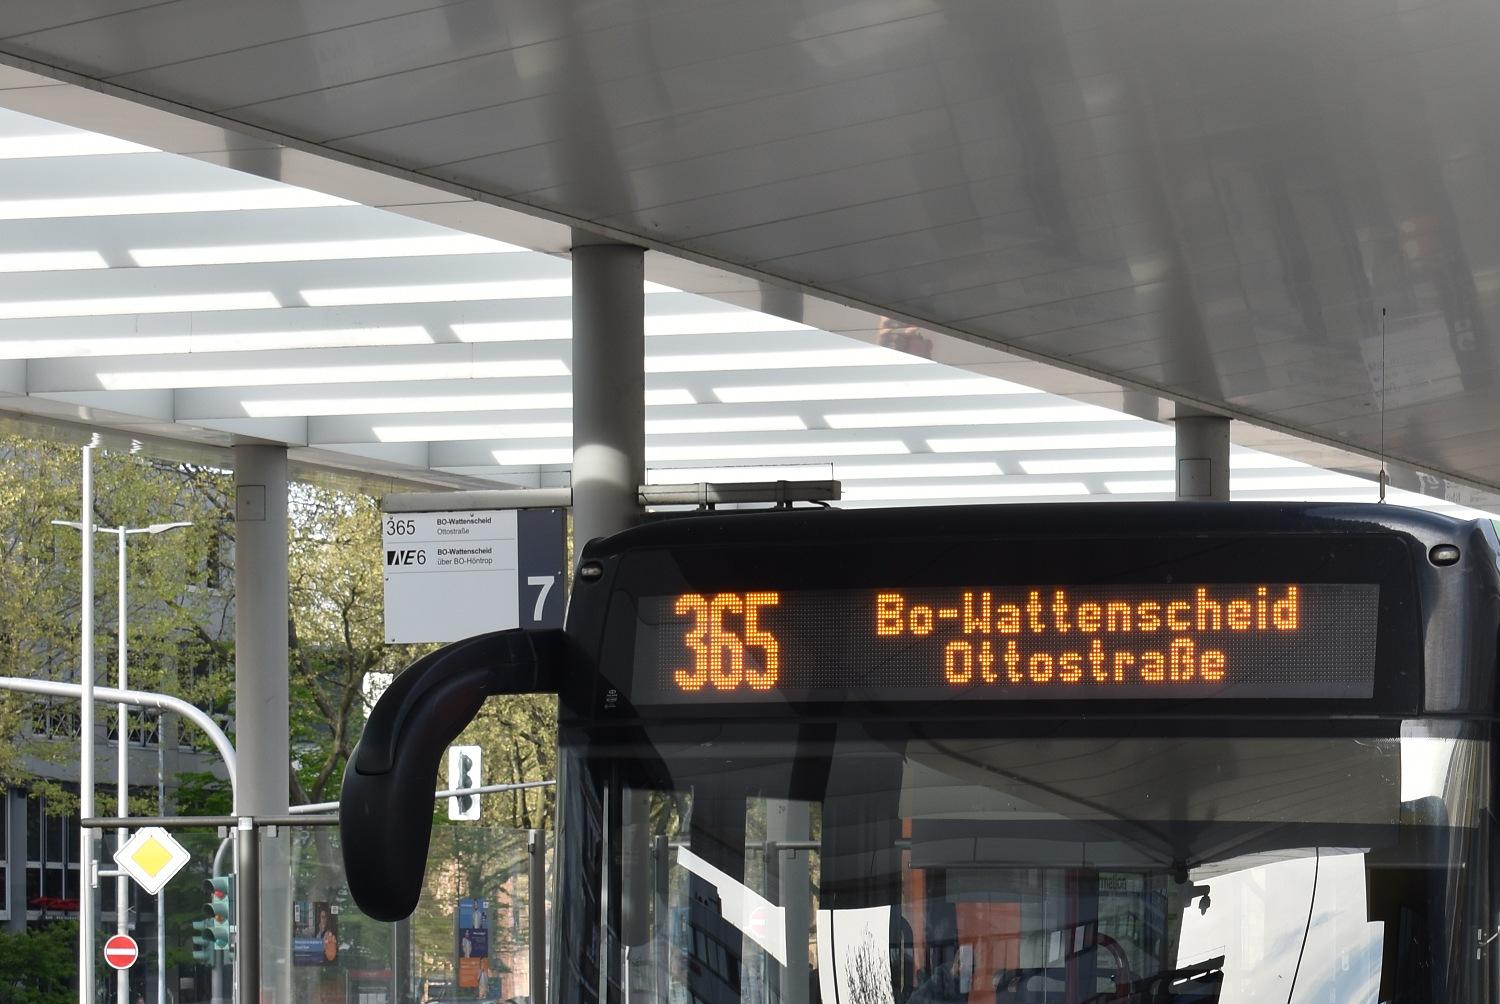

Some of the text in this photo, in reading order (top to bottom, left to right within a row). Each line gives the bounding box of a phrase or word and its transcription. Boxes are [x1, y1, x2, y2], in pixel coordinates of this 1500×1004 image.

[386, 519, 416, 536] 365
[436, 517, 492, 526] BO-Wattenscheid
[436, 527, 470, 536] Ottostraße
[437, 547, 493, 556] BO-Wattenscheid
[437, 557, 493, 566] über BO-Höntrop
[527, 575, 555, 622] 7
[876, 585, 1299, 637] Bo-Wattenscheid
[674, 592, 779, 691] 365
[943, 637, 1227, 685] Ottostraße
